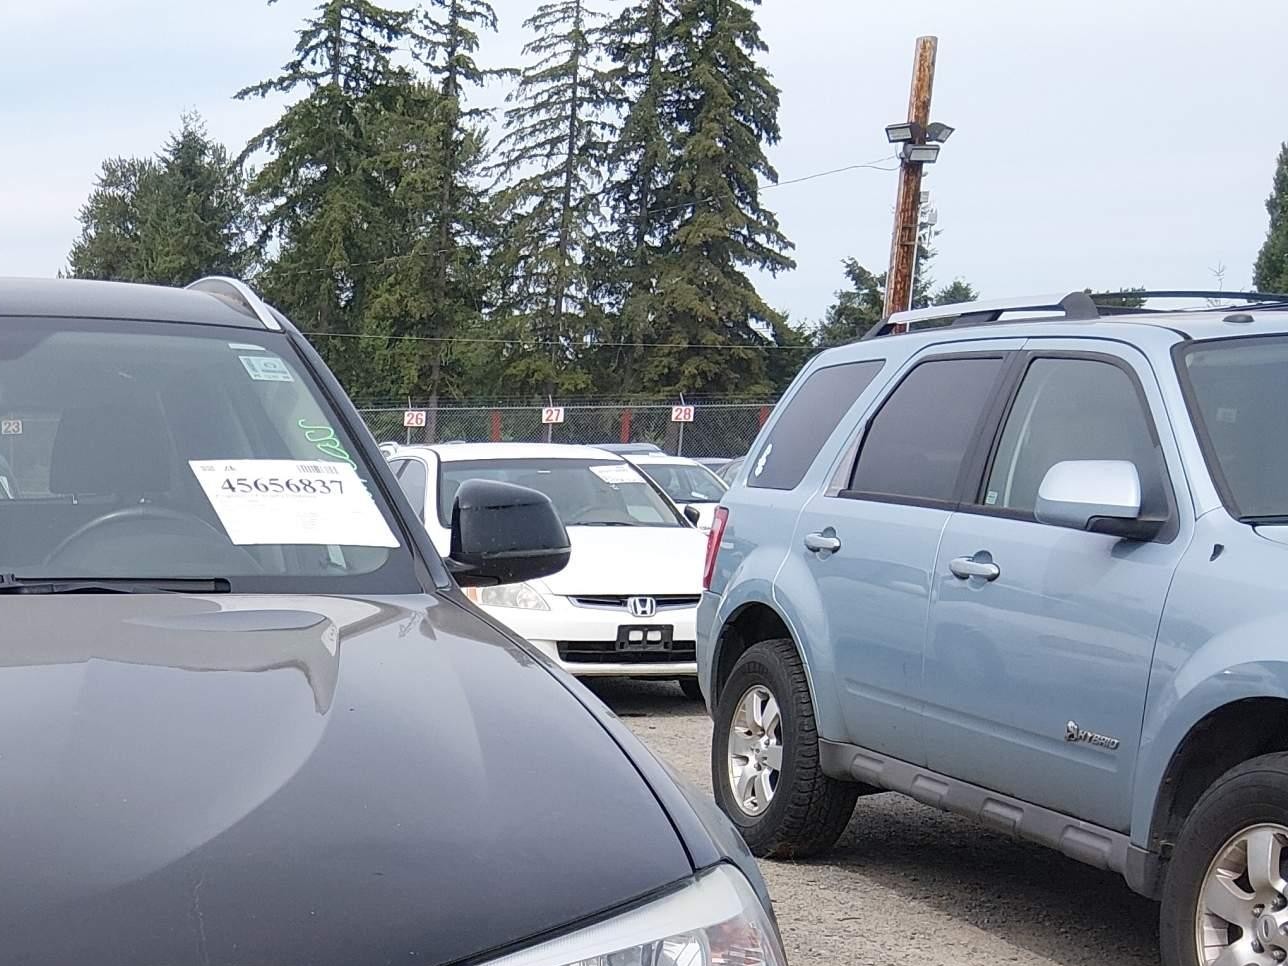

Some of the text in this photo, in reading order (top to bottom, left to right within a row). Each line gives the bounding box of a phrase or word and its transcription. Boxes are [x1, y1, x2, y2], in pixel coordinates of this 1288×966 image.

[406, 412, 424, 425] 26
[545, 408, 561, 422] 27
[674, 407, 692, 421] 28
[3, 421, 21, 433] 23
[221, 477, 344, 495] 45656837
